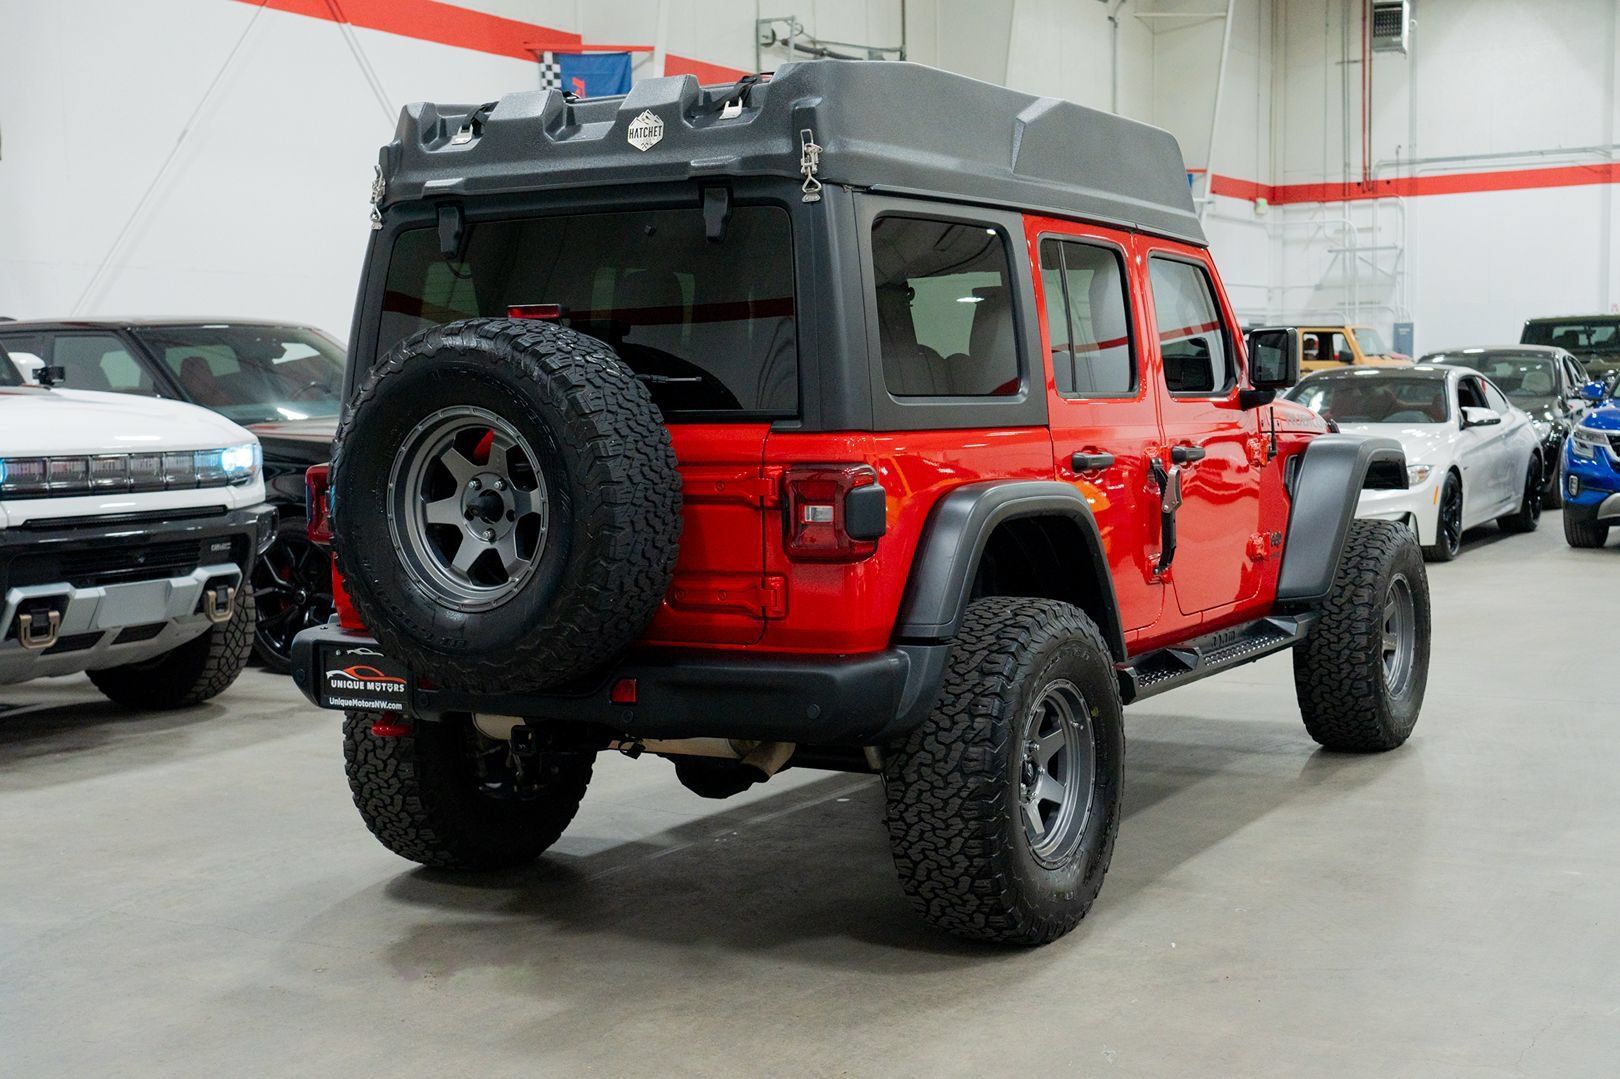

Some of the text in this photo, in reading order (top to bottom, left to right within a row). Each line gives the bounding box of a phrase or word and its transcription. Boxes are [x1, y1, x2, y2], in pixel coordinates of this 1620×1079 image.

[629, 125, 662, 139] HATCHET
[331, 679, 405, 692] UNIQUE MOTORS
[329, 697, 402, 710] UniqueMotorsNW.com
